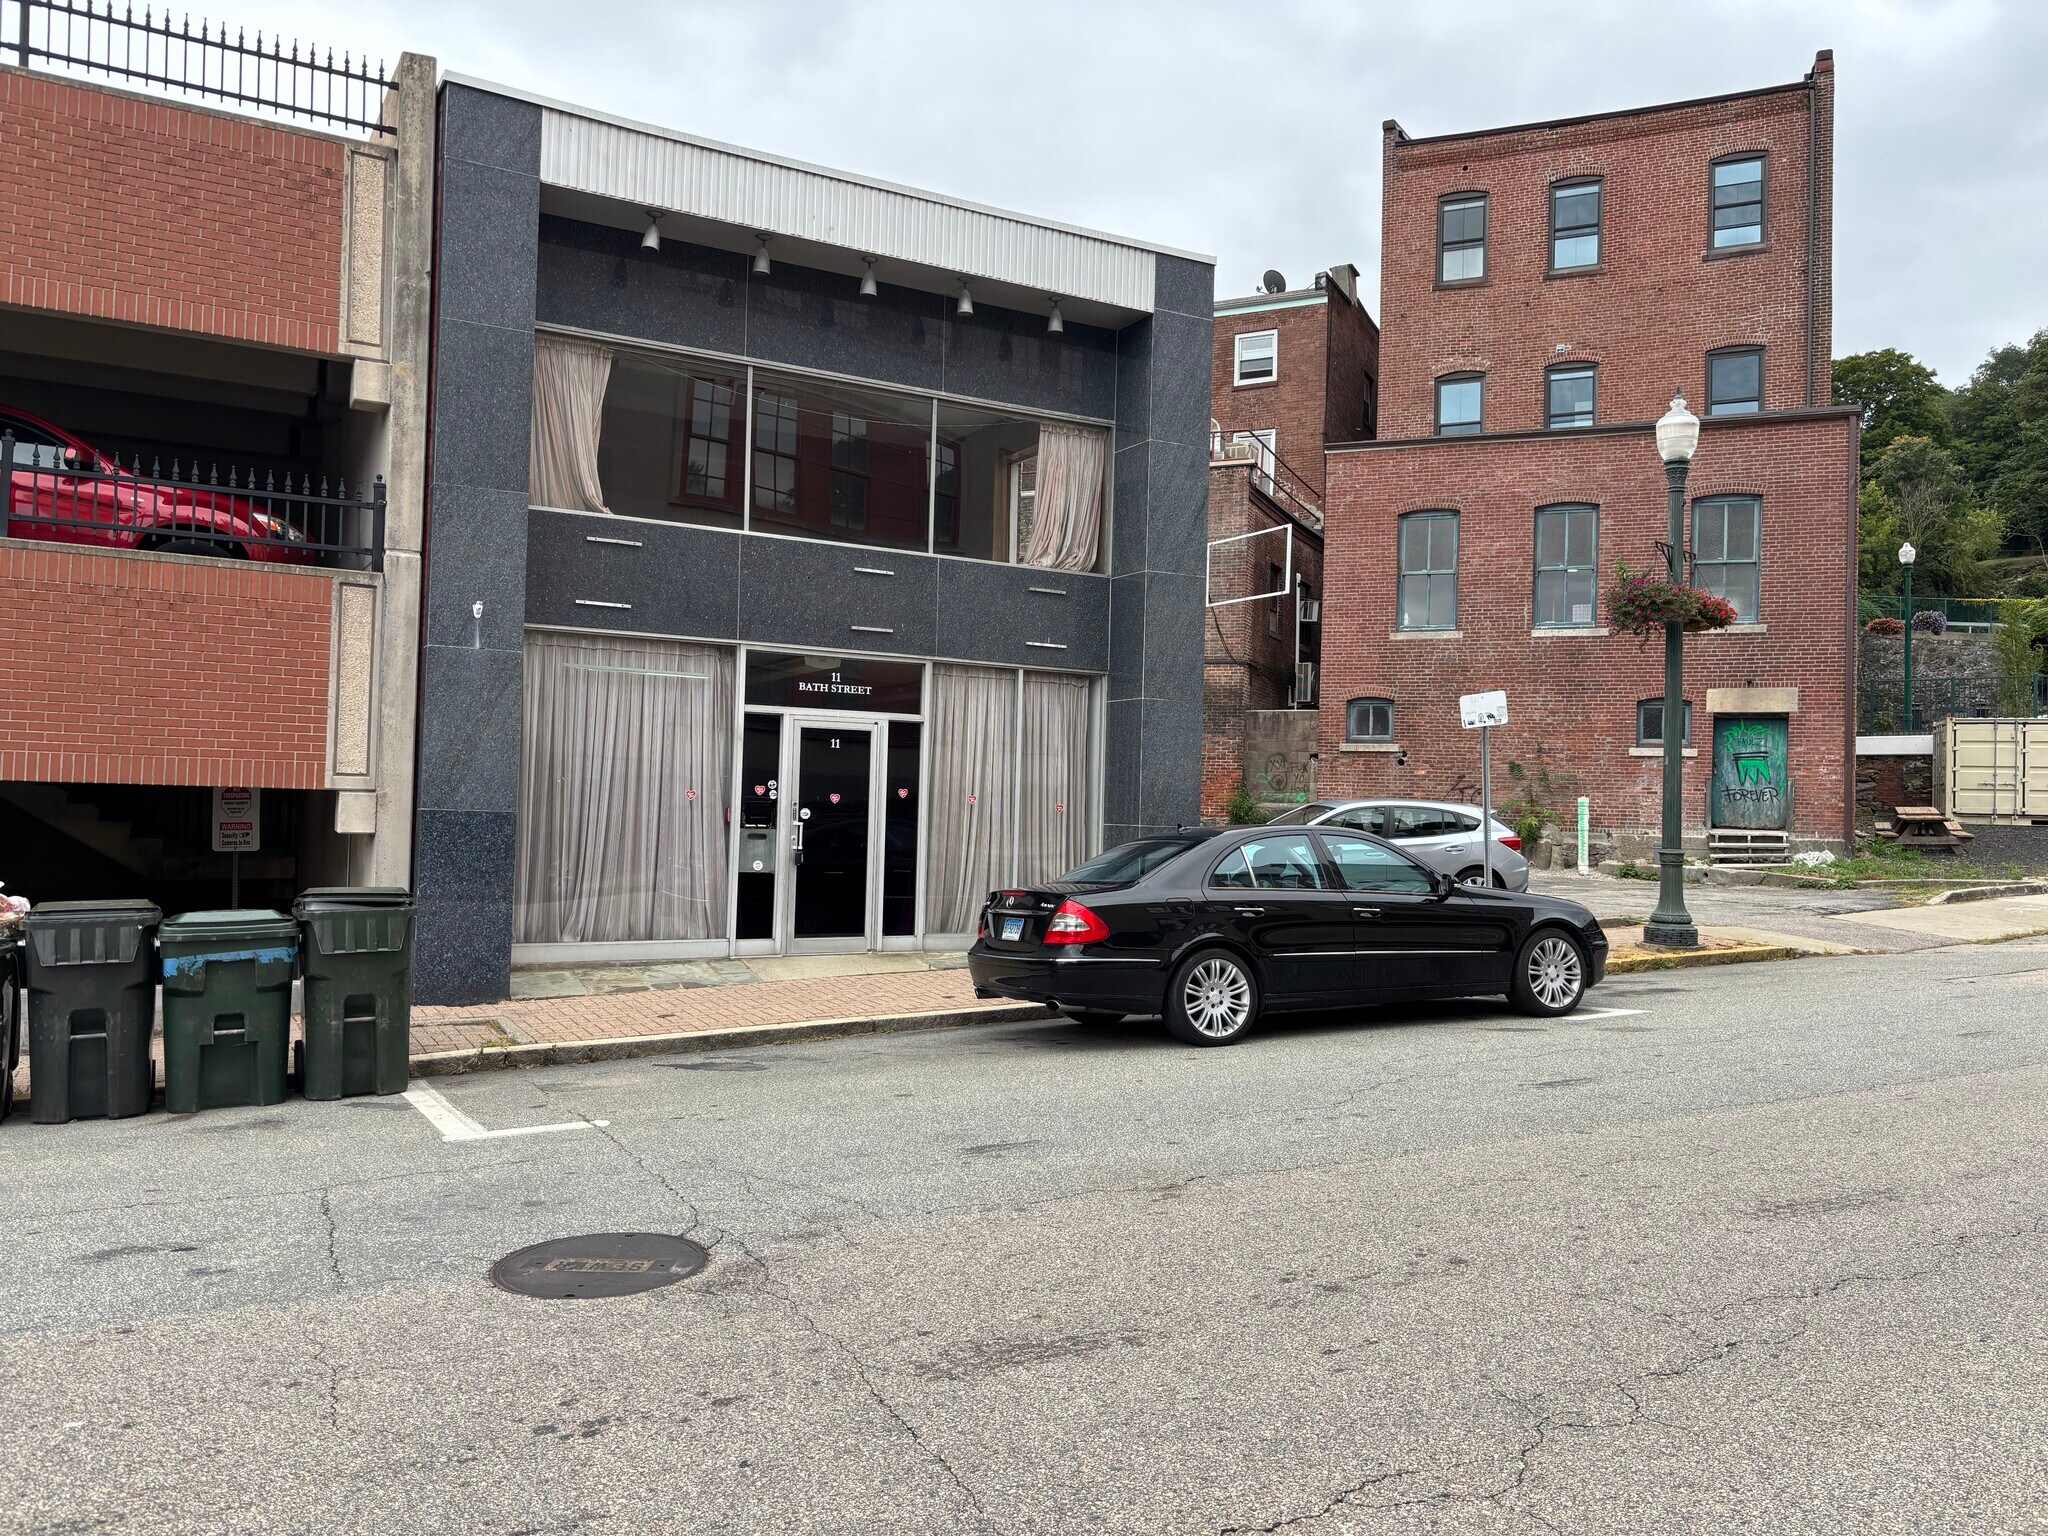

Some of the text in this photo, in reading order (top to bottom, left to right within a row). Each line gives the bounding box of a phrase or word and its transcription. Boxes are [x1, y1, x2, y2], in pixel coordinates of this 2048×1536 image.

[831, 672, 841, 682] 11
[798, 681, 873, 695] BATH STREET
[830, 738, 841, 749] 11
[1721, 785, 1781, 804] FOREVER
